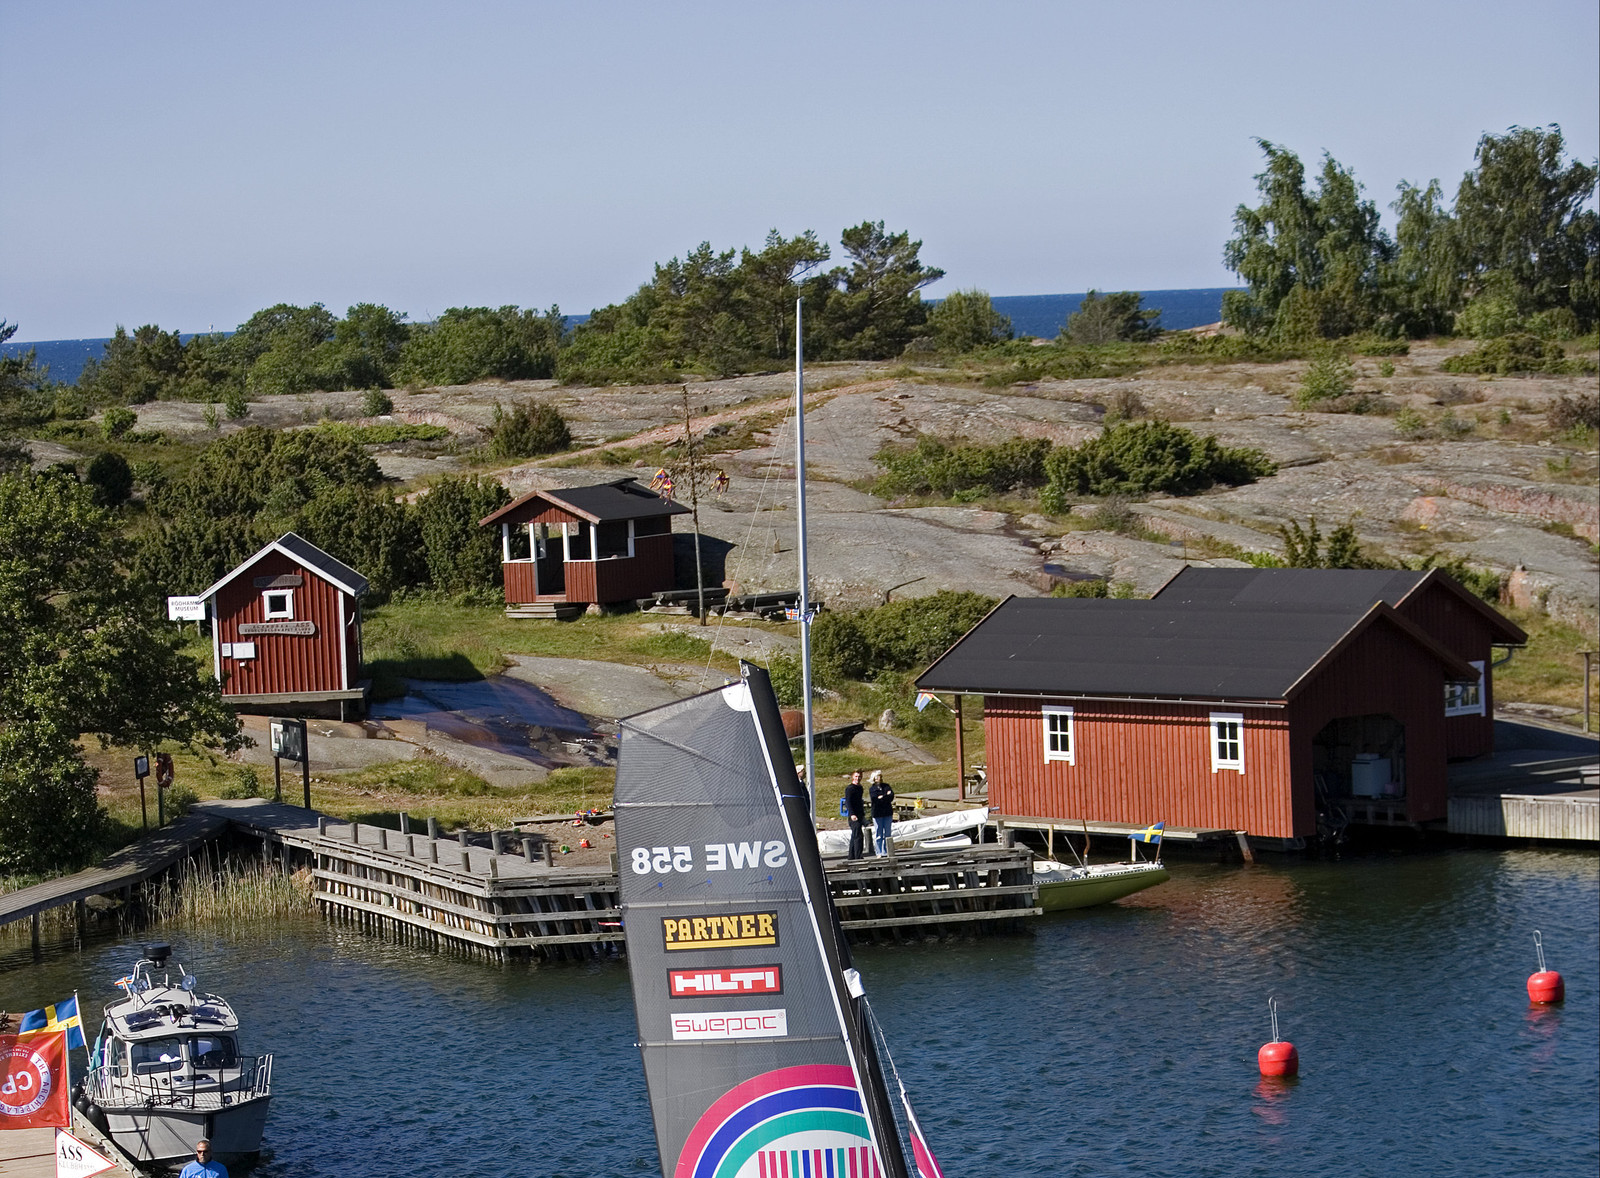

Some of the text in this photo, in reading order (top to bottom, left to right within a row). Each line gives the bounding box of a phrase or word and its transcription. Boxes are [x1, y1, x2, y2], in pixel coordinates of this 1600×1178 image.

[664, 914, 775, 941] PARTNER
[675, 971, 775, 992] HILTI
[675, 1016, 777, 1035] swepac
[35, 1057, 49, 1076] THE
[2, 1071, 33, 1095] CP
